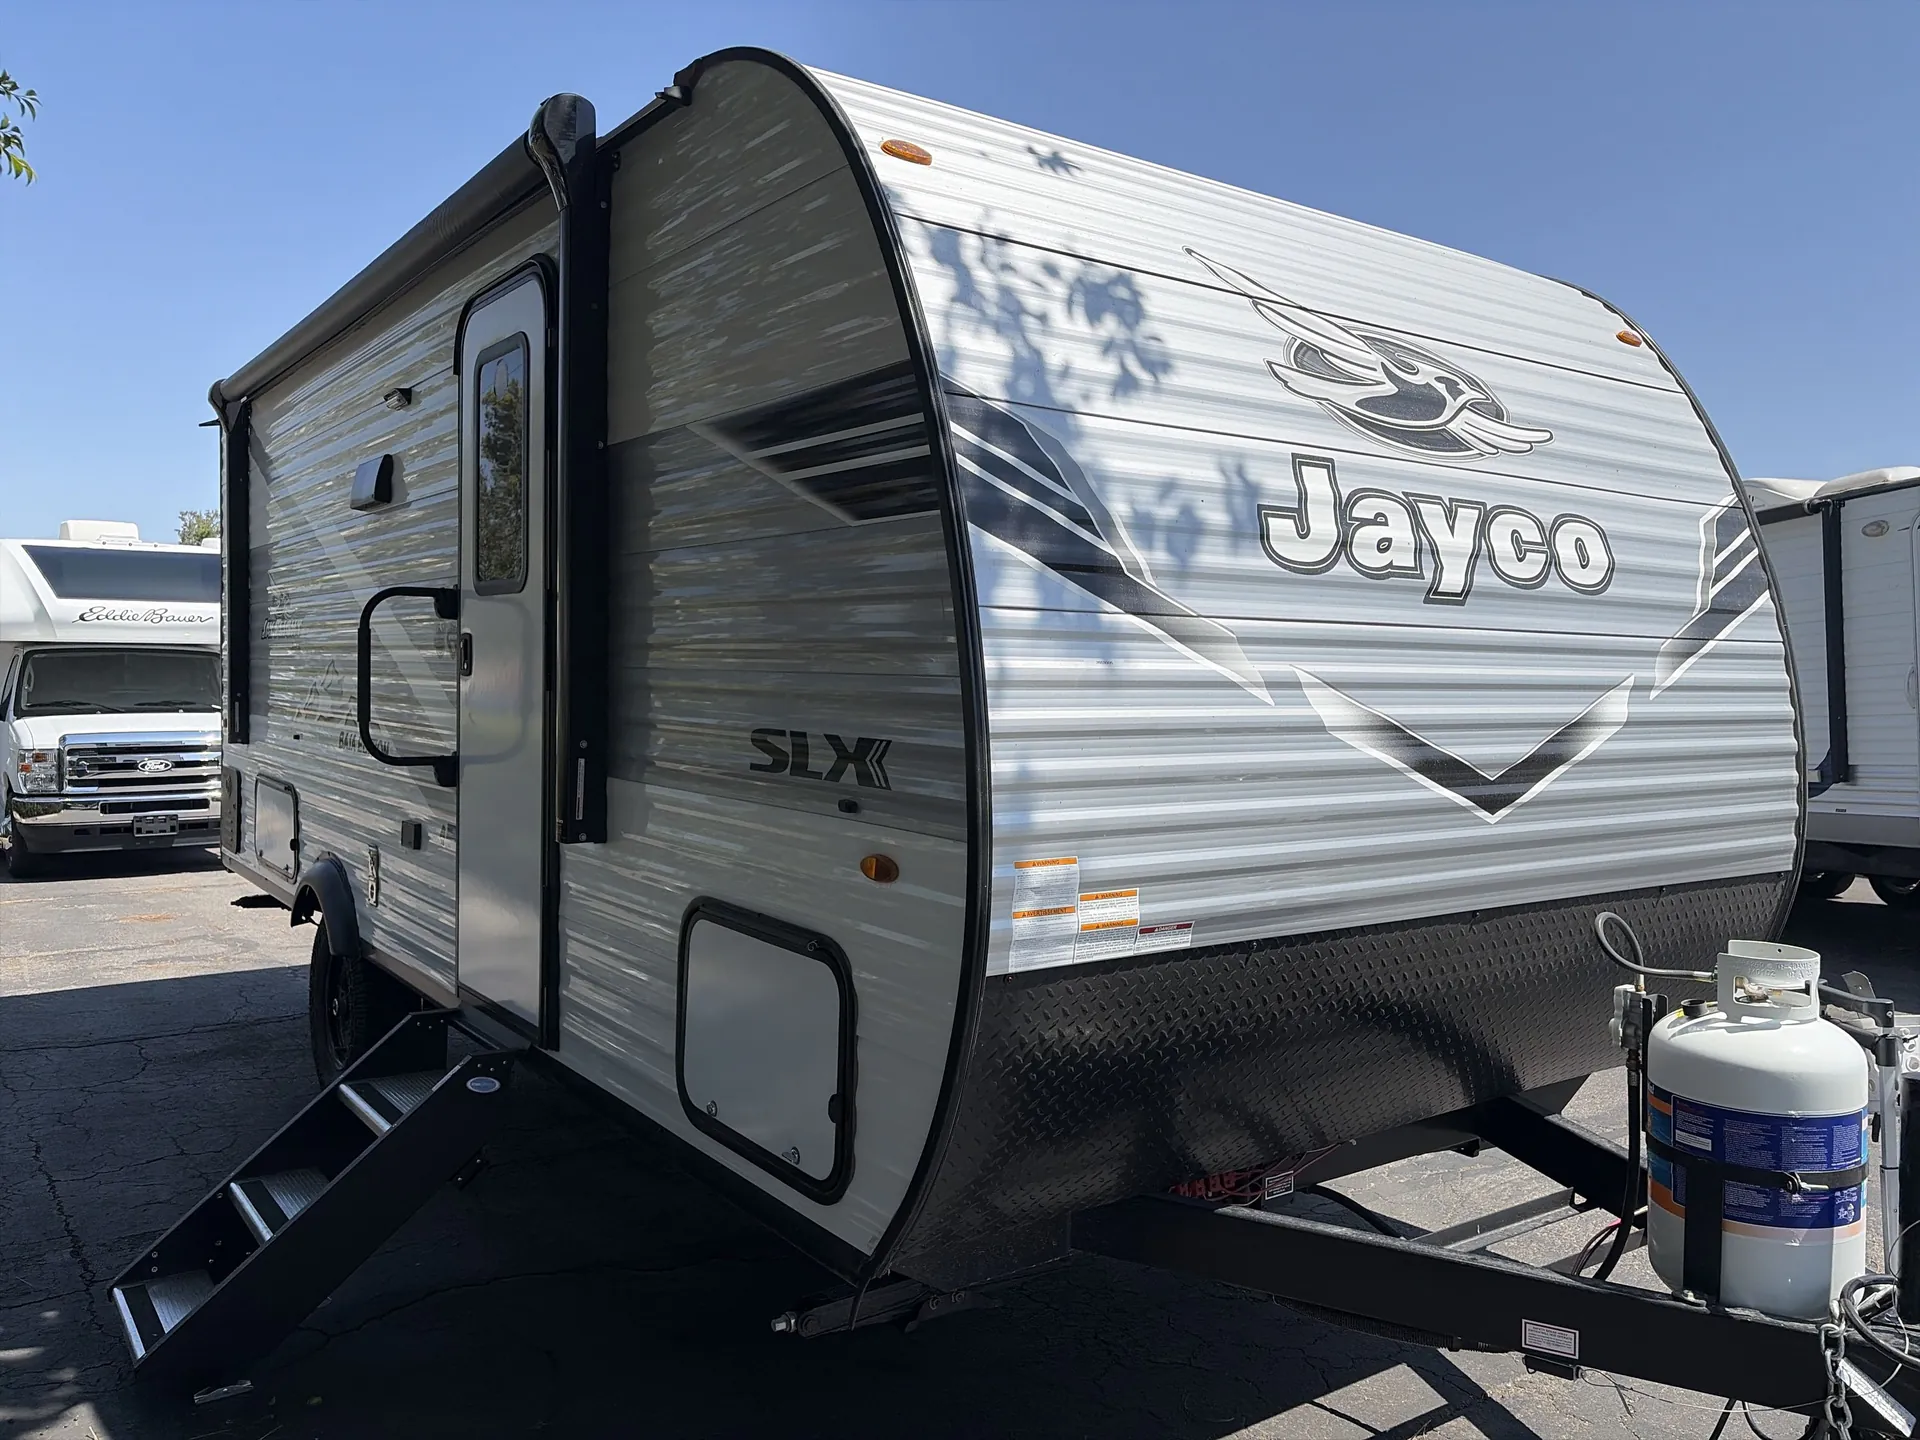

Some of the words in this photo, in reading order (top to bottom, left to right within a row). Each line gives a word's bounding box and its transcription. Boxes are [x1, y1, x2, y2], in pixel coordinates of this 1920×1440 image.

[1257, 452, 1616, 607] Jayco
[72, 606, 141, 623] Eddie
[142, 608, 214, 624] Bauer
[750, 728, 892, 791] SLX
[1036, 859, 1060, 867] WARNING
[1101, 891, 1123, 899] WARNING
